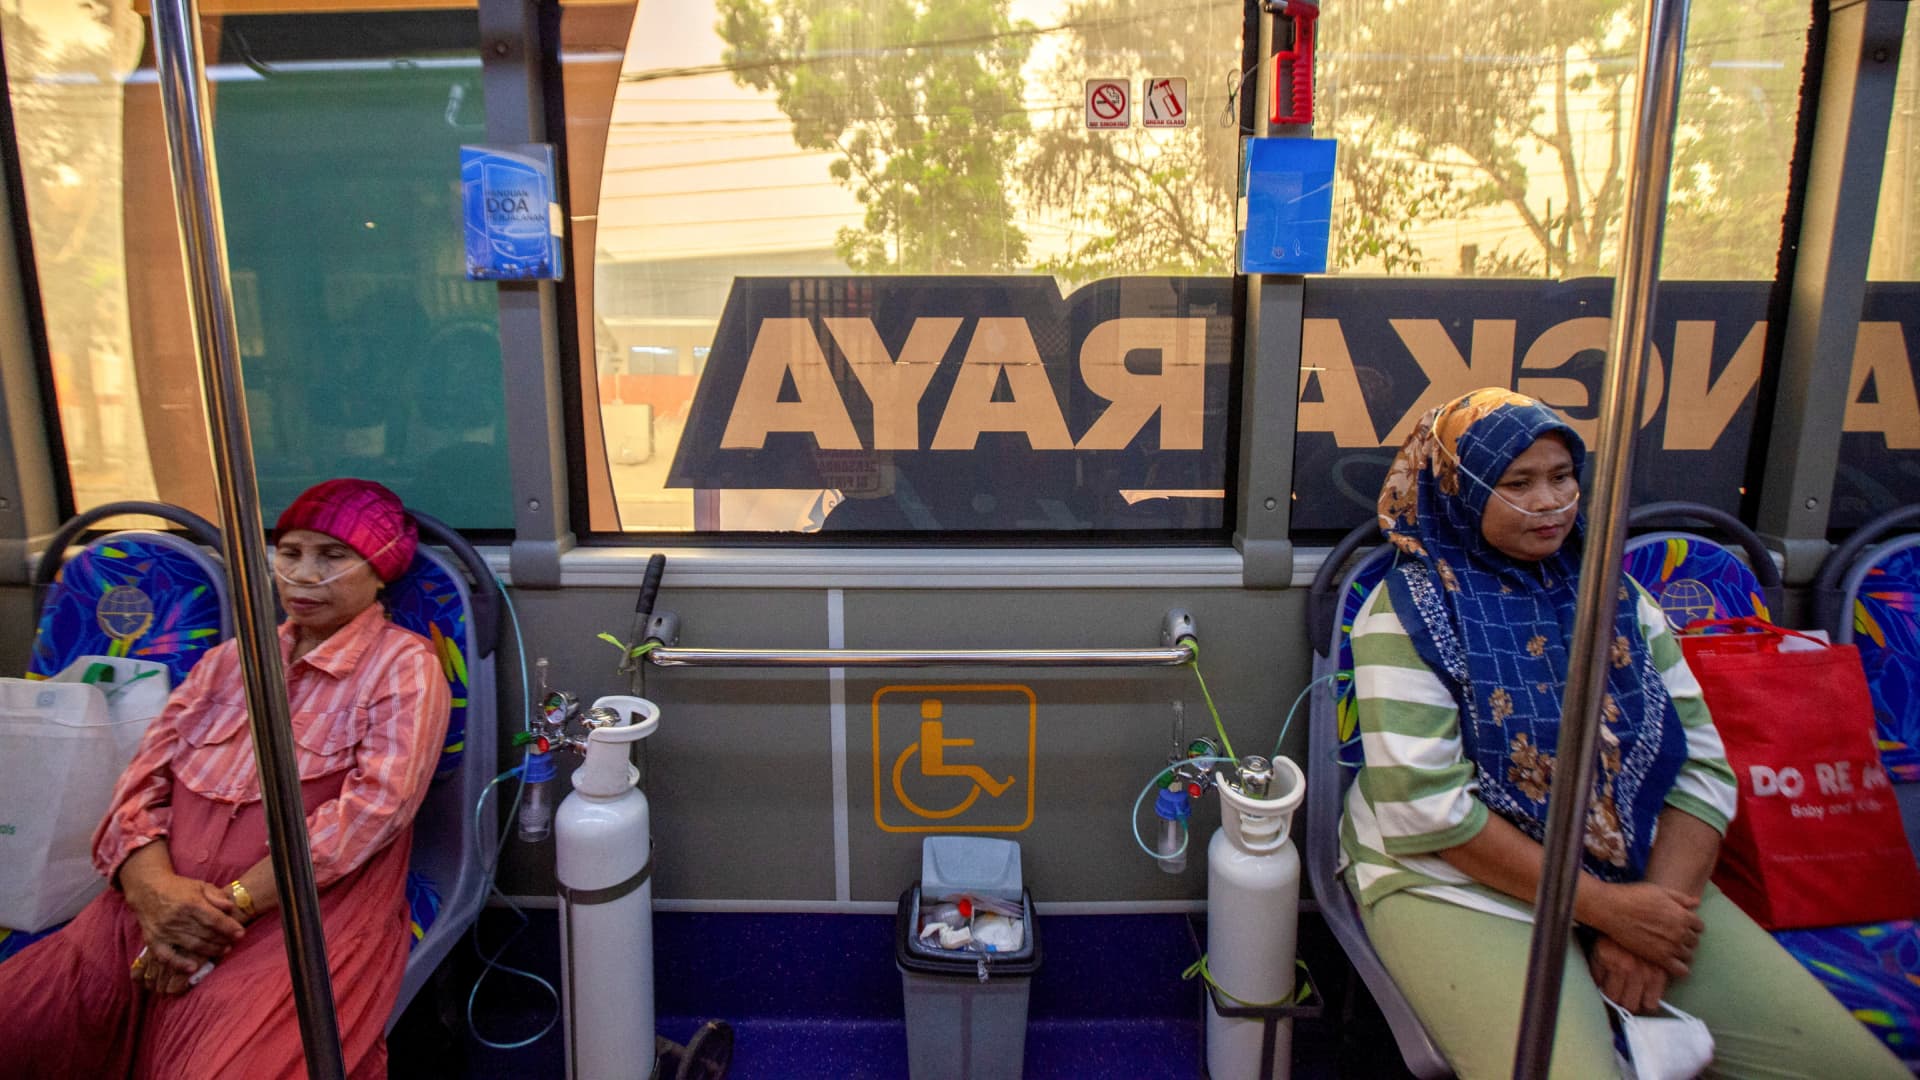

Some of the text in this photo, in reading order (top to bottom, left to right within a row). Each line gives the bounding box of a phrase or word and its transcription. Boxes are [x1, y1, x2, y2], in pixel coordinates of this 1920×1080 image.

[487, 198, 529, 213] DOA
[1750, 765, 1805, 798] DO
[1815, 761, 1854, 796] RE
[1791, 803, 1824, 820] Baby
